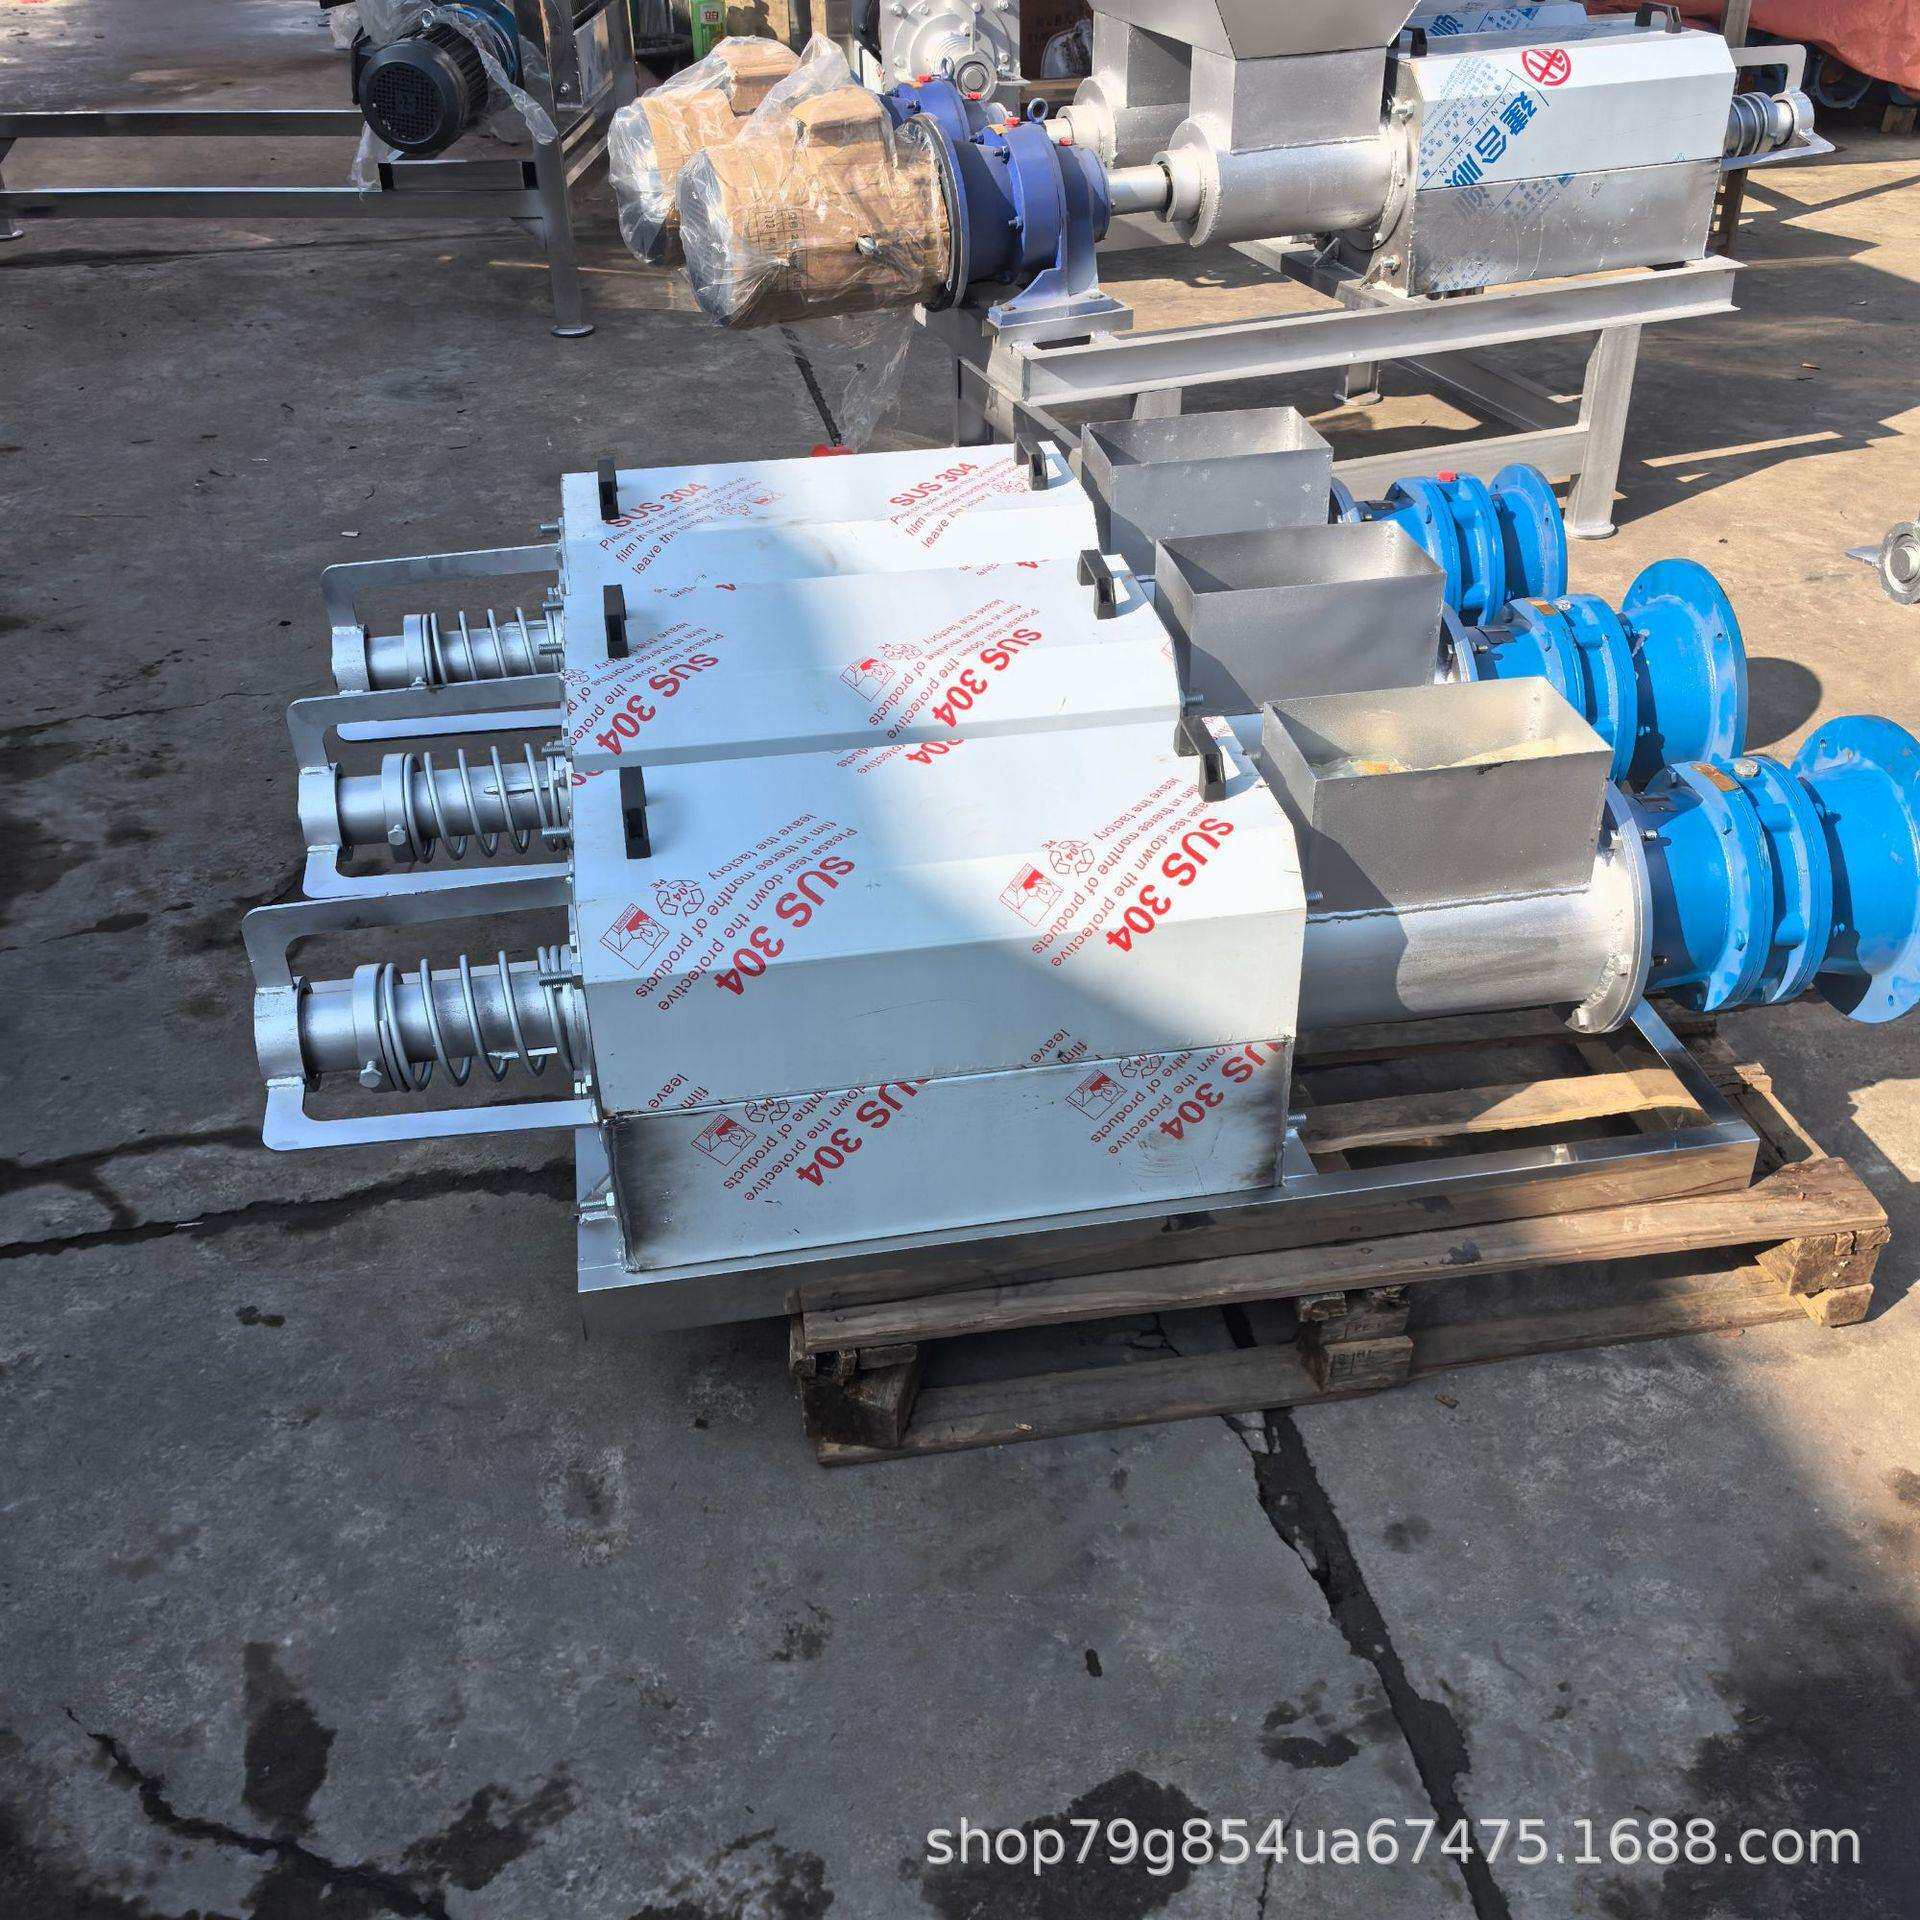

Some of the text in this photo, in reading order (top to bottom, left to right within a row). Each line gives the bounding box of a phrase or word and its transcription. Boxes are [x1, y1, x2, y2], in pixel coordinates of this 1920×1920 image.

[889, 482, 943, 506] SUS
[935, 462, 980, 484] 304
[604, 502, 665, 528] SUS
[660, 482, 708, 503] 304
[615, 541, 638, 563] film
[921, 519, 950, 549] leave
[632, 544, 662, 575] leave
[916, 660, 926, 678] of
[931, 628, 1043, 728] SUS 304
[939, 656, 960, 679] the
[577, 686, 591, 703] of
[595, 653, 719, 756] SUS 304
[604, 684, 628, 705] the
[869, 673, 915, 727] products
[887, 677, 941, 740] protective
[570, 703, 606, 746] protec
[837, 746, 873, 768] ducts
[1094, 776, 1184, 841] leave the factory
[1171, 795, 1186, 809] in
[1181, 782, 1199, 800] ilm
[797, 831, 815, 846] in
[809, 820, 838, 839] film
[1168, 815, 1192, 835] tear
[708, 812, 818, 881] leave the factory
[1098, 830, 1140, 876] monthe
[1135, 832, 1169, 871] down
[1162, 818, 1235, 887] SUS
[673, 887, 687, 901] 04
[707, 870, 758, 916] monthe
[1084, 876, 1099, 897] of
[1114, 871, 1138, 898] the
[658, 826, 859, 1011] Please tear down the protective
[691, 917, 708, 938] of
[714, 856, 856, 996] SUS 304
[1032, 890, 1086, 954] products
[1051, 895, 1116, 967] protective
[1106, 884, 1172, 952] 304
[635, 933, 693, 998] products
[1030, 1028, 1071, 1063] leave
[1059, 1040, 1088, 1065] film
[647, 1073, 690, 1109] leave
[680, 1085, 710, 1110] film
[1090, 1050, 1193, 1144] nthe of products
[1172, 1073, 1198, 1094] the
[806, 1118, 833, 1141] the
[1108, 1093, 1174, 1154] protective
[1159, 1081, 1225, 1141] 304
[776, 1122, 793, 1141] of
[795, 1078, 931, 1188] US 304
[723, 1135, 779, 1191] products
[744, 1137, 808, 1201] protective
